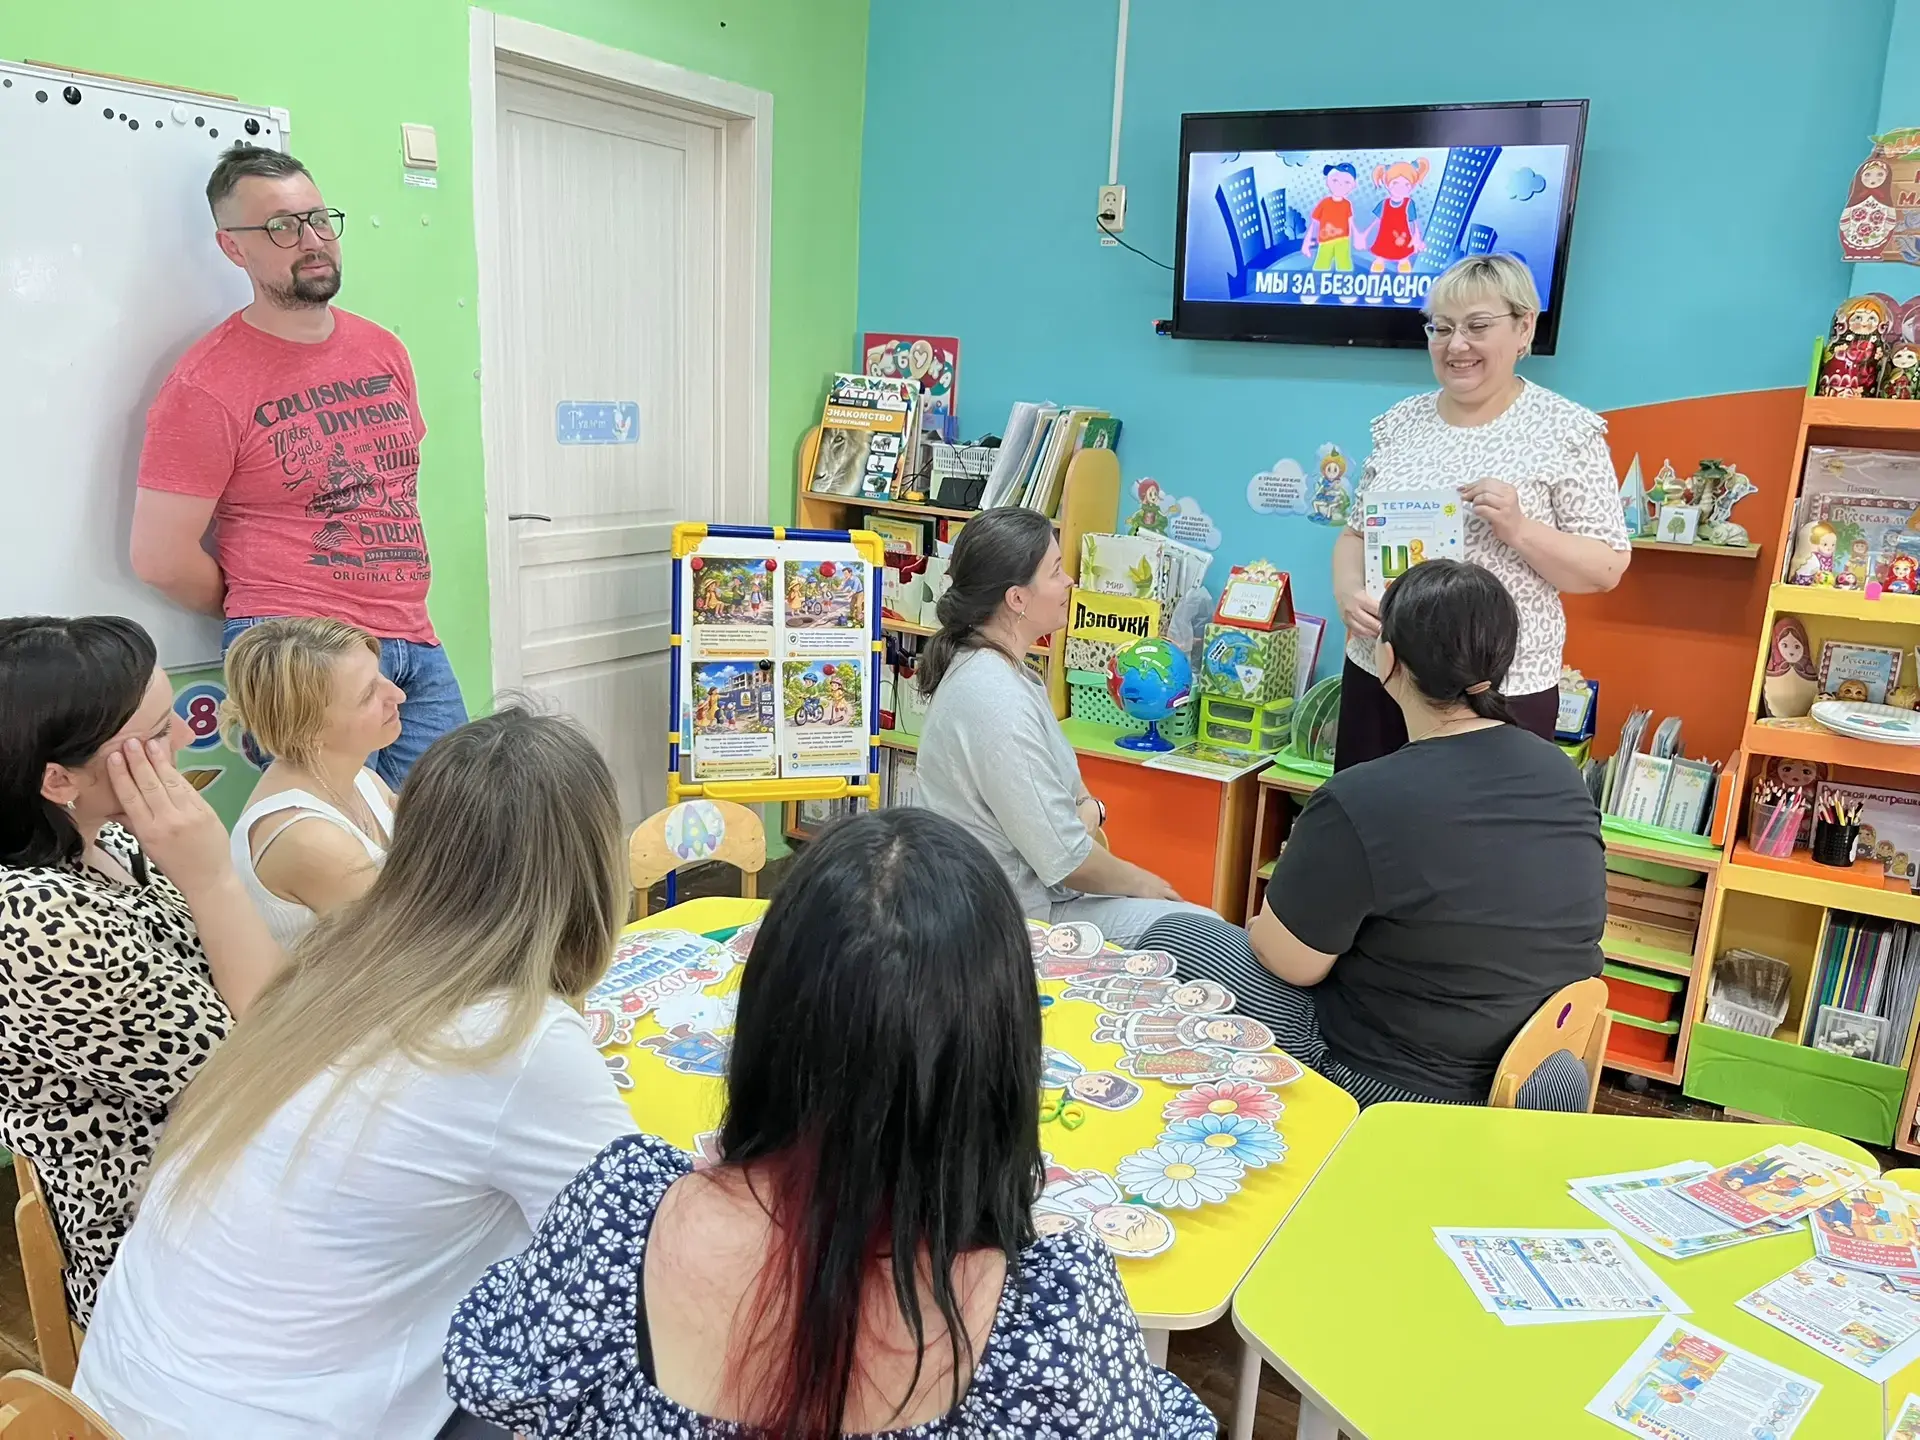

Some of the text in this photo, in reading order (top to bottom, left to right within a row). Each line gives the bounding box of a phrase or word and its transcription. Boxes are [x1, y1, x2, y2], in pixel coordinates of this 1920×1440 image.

[1256, 271, 1288, 294] МЫ
[1292, 273, 1316, 294] ЗА
[254, 377, 372, 427] CRUISING
[315, 400, 409, 436] DIVISION
[827, 408, 894, 422] ЗНАКОМСТВО
[268, 422, 315, 458] Motor
[281, 437, 324, 476] Cycle
[343, 510, 391, 523] SOUTHERN
[1381, 502, 1440, 510] ТЕТРАДЬ
[333, 570, 391, 582] ORIGINAL
[395, 567, 406, 582] &
[1074, 602, 1149, 638] Лэпбуки
[664, 943, 703, 963] ГОД
[633, 968, 699, 1003] 2026
[1612, 1202, 1656, 1233] ПАМЯТКА
[1461, 1250, 1497, 1293] ПАМЯТКА
[1766, 1309, 1845, 1352] ПАМЯТКА
